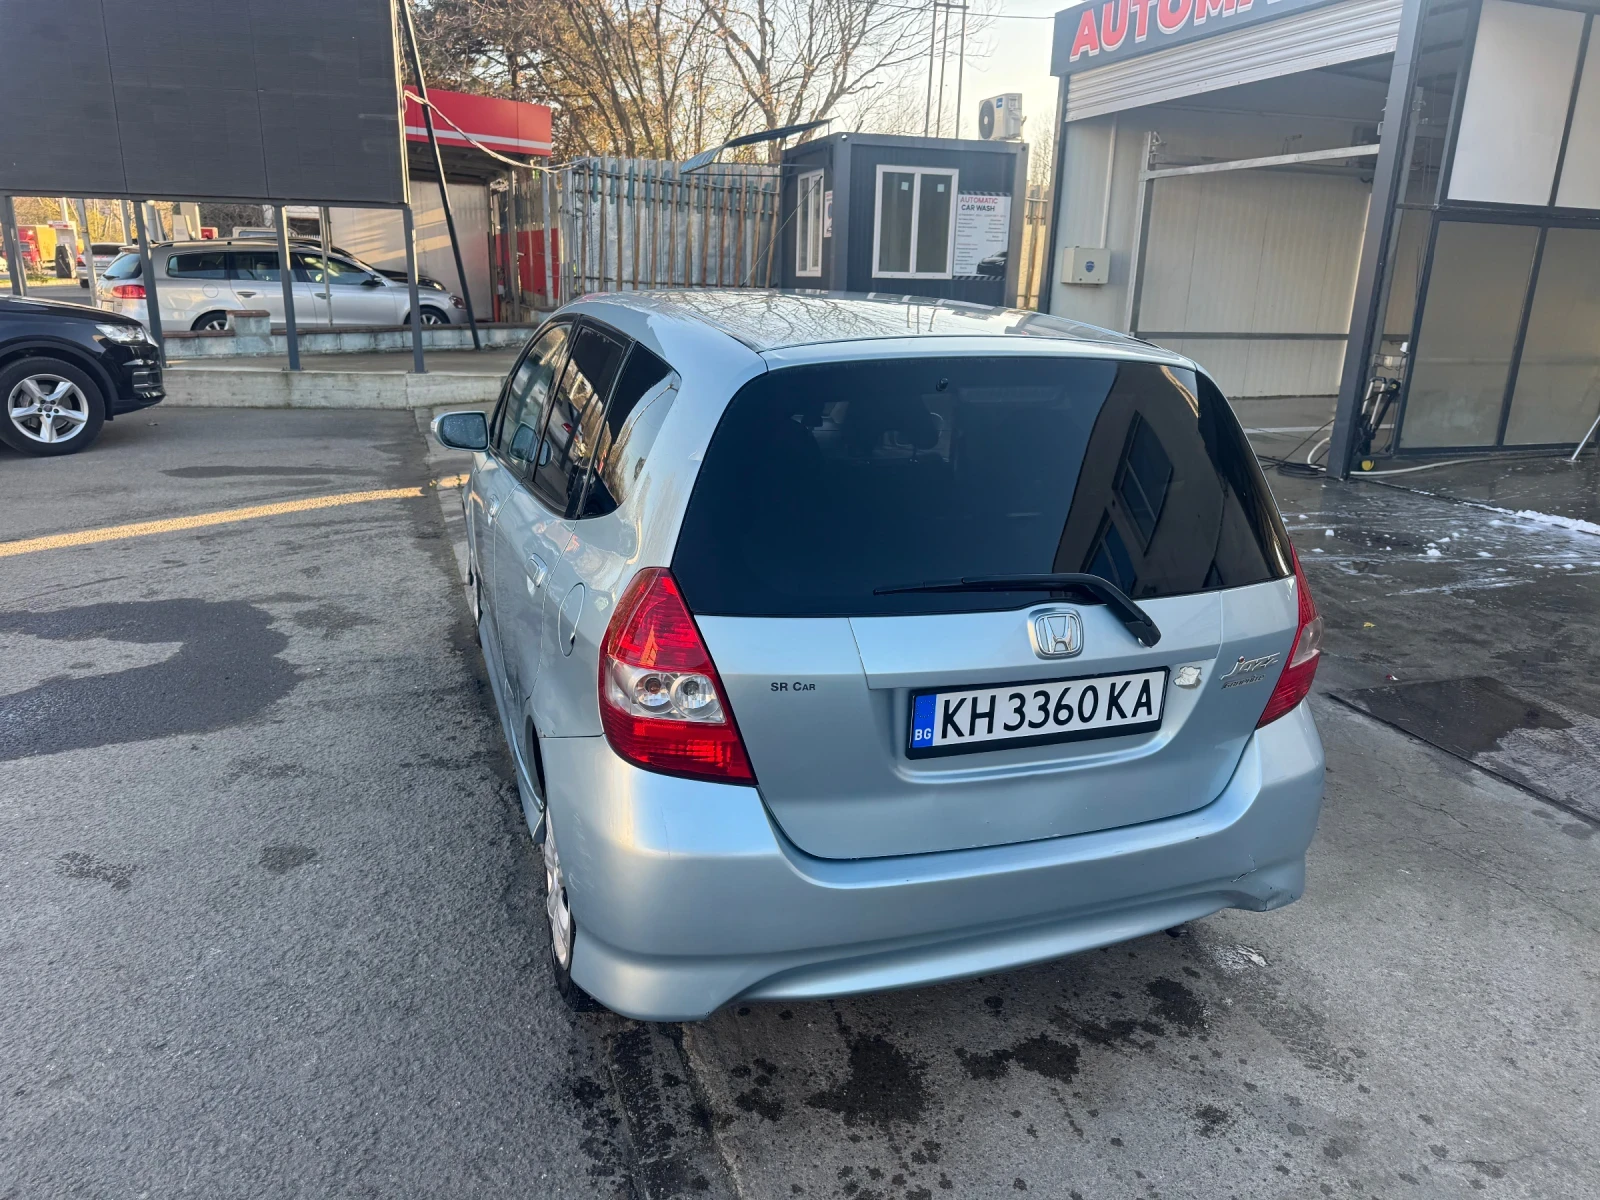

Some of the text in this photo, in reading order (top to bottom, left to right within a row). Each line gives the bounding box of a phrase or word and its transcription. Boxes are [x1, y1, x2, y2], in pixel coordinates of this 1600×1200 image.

[1069, 0, 1290, 63] AUTO
[960, 196, 999, 204] AUTOMATIC
[770, 682, 788, 691] SR
[914, 728, 932, 741] BG
